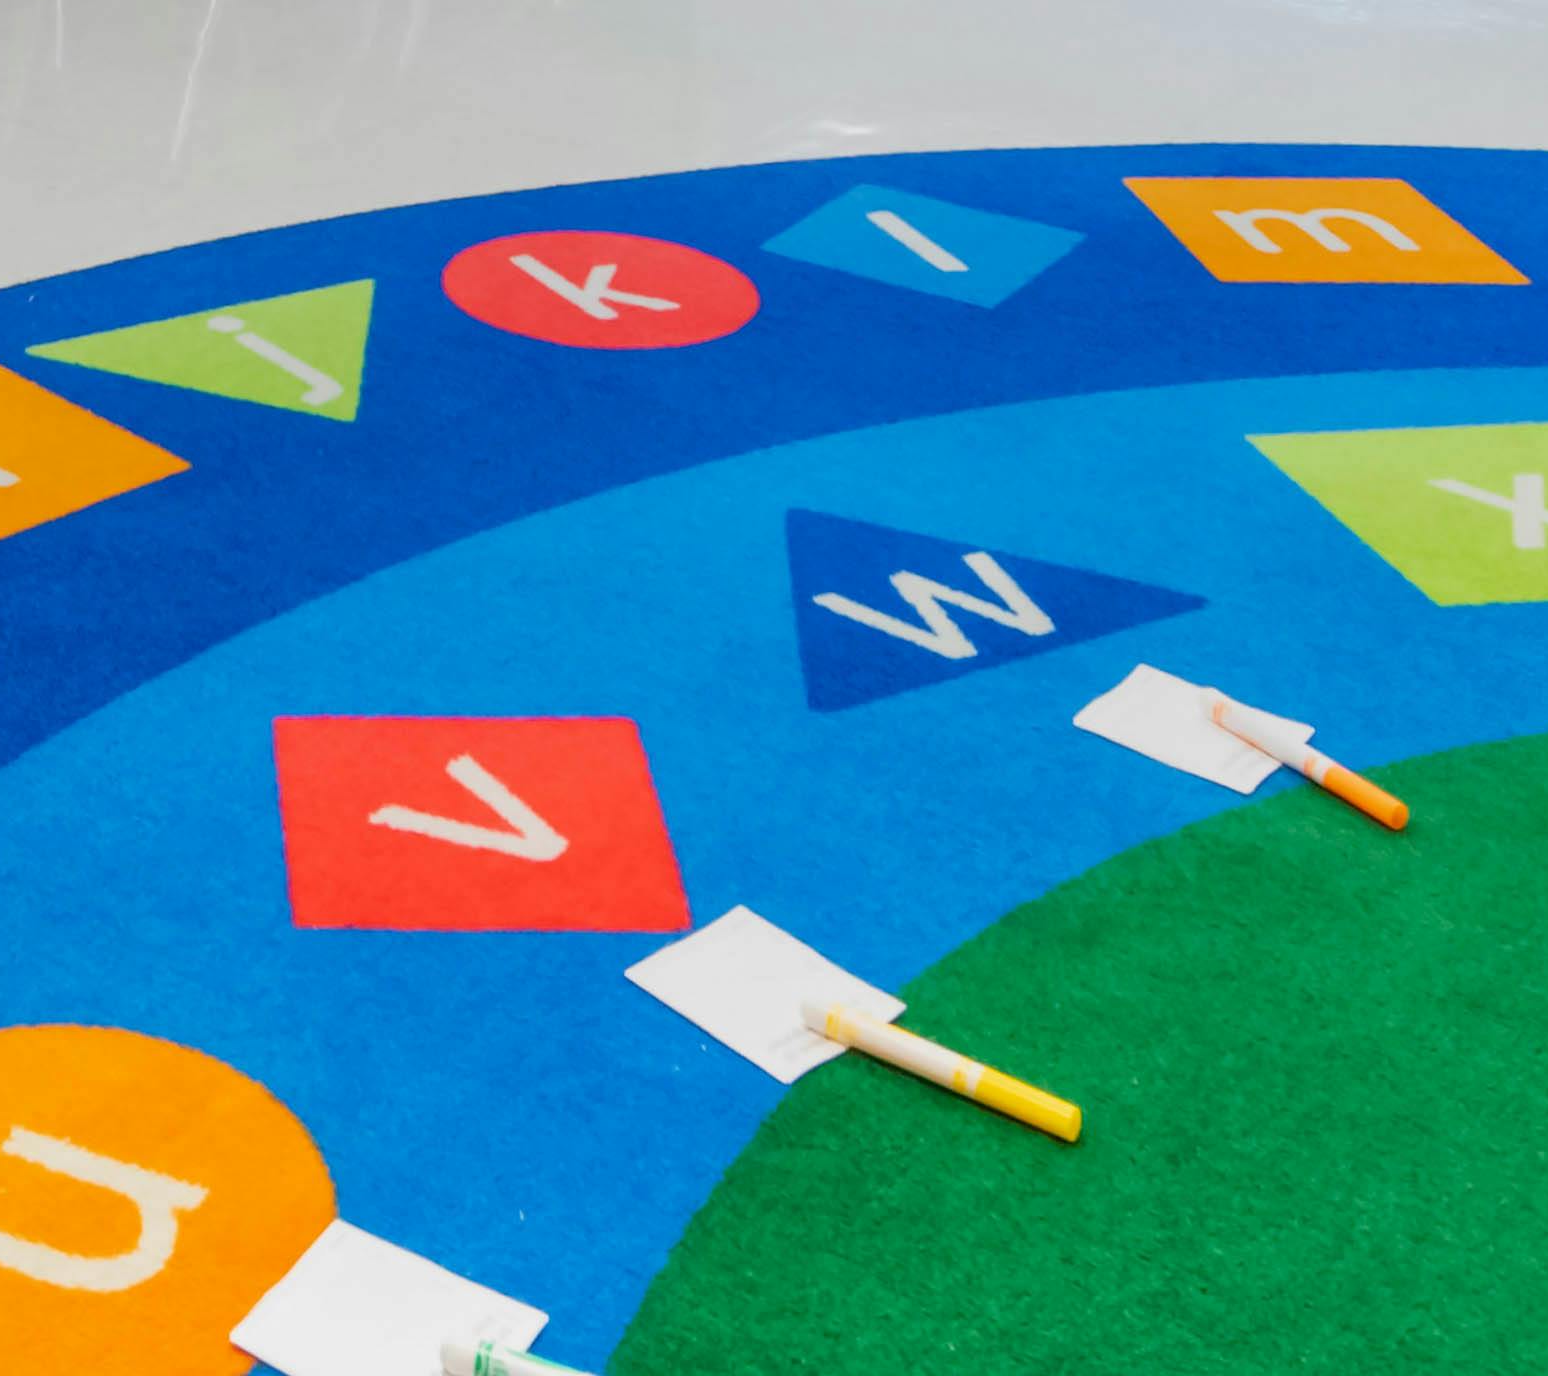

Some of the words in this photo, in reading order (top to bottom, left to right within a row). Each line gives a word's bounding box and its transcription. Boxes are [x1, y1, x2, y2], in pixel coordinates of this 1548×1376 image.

[1214, 207, 1419, 254] m
[511, 254, 681, 321] k
[206, 313, 344, 407] j
[813, 552, 1054, 660] w
[370, 756, 568, 861] v
